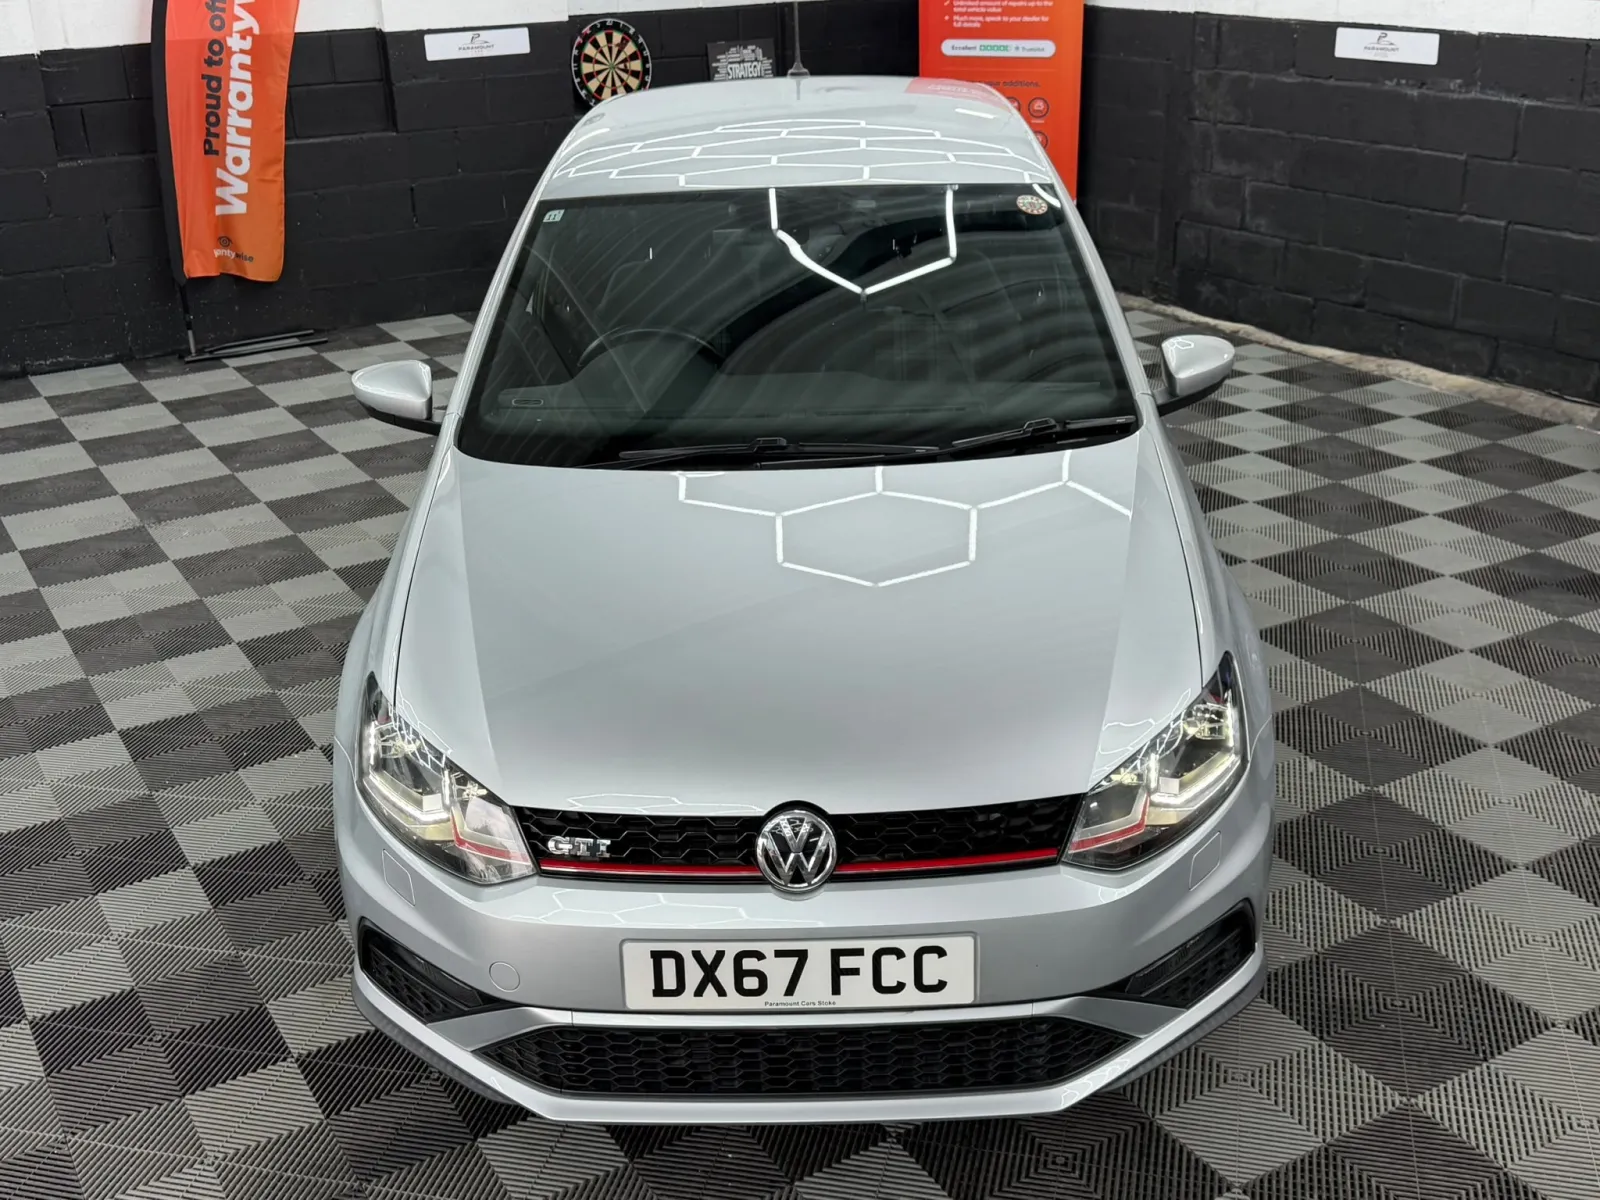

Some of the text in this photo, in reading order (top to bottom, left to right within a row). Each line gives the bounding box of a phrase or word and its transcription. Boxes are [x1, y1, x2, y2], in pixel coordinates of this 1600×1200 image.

[204, 38, 224, 68] to
[728, 61, 762, 79] STRATEGY
[201, 73, 222, 157] Proud
[215, 0, 260, 217] Warranty
[548, 835, 612, 858] GTI
[650, 945, 948, 997] DX67 FCC
